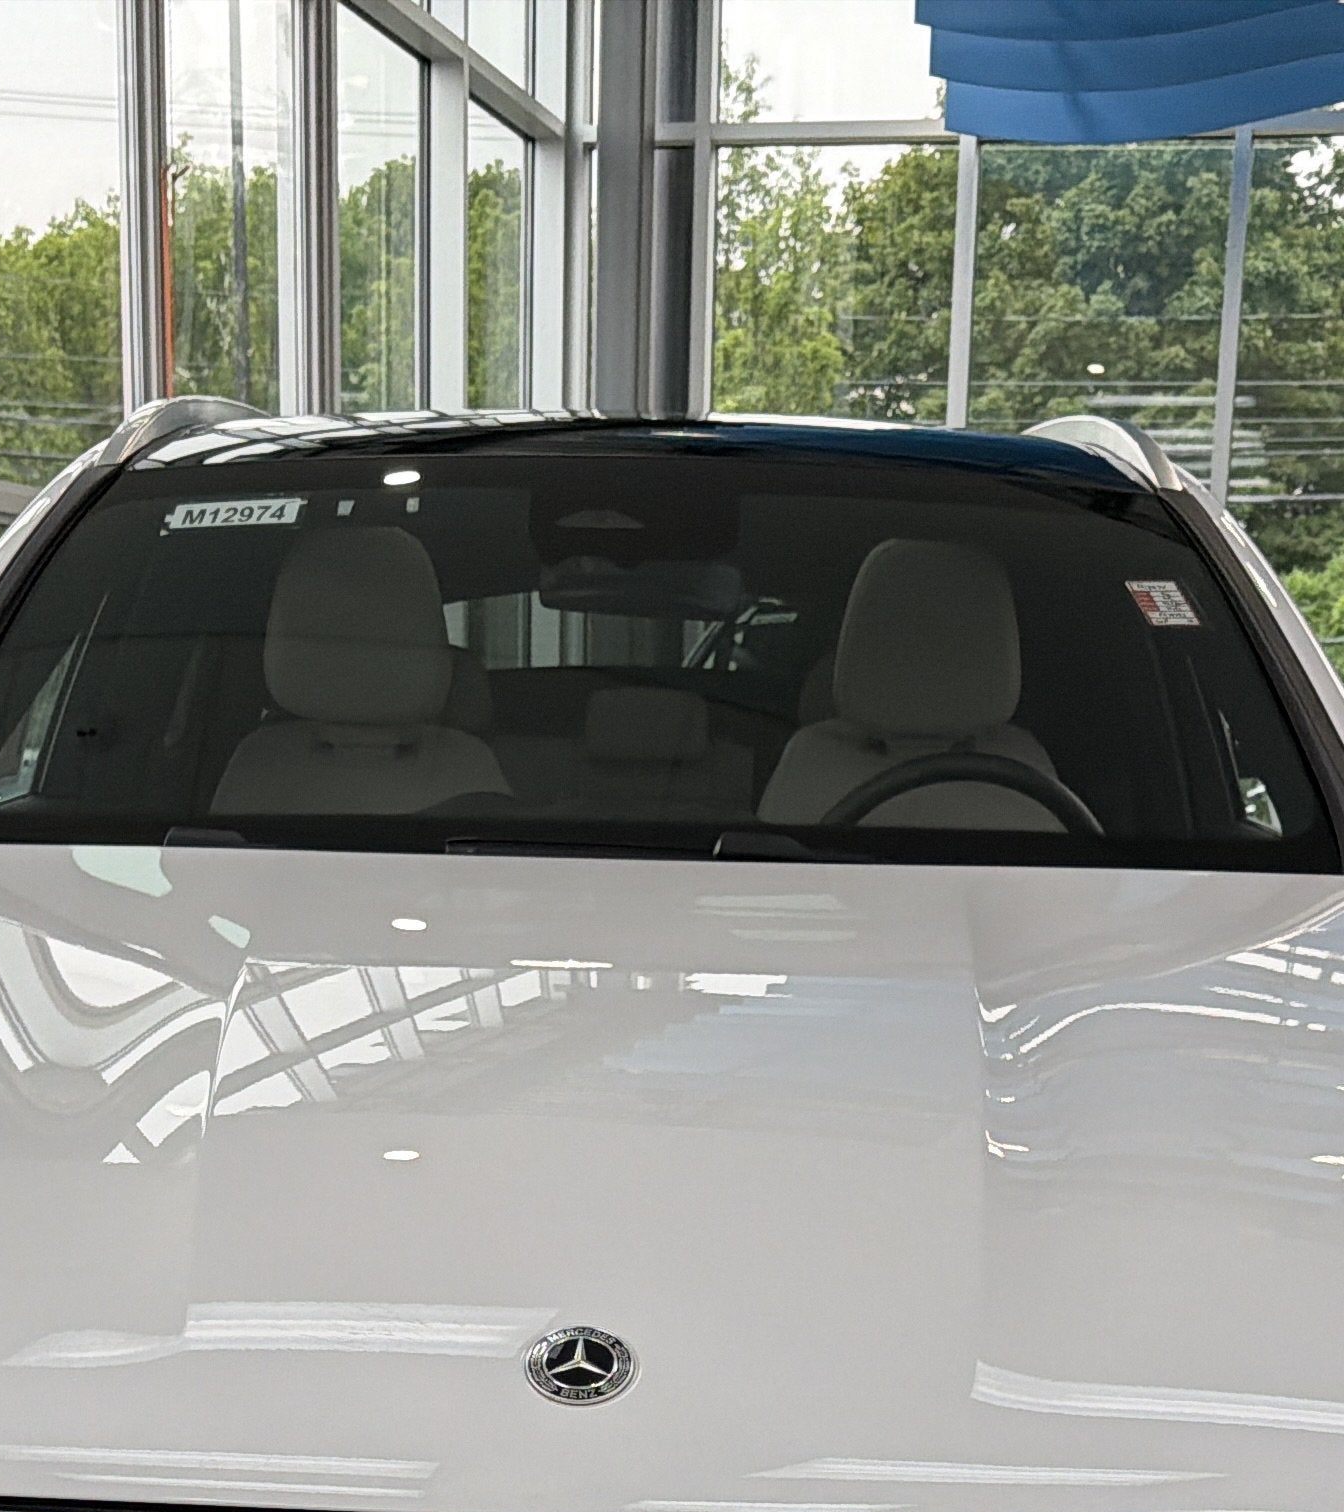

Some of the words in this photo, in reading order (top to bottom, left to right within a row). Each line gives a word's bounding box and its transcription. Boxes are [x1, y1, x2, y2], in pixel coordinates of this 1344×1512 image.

[181, 503, 286, 526] M12974
[546, 1328, 616, 1345] MERCEDES
[559, 1389, 598, 1399] BENZ
